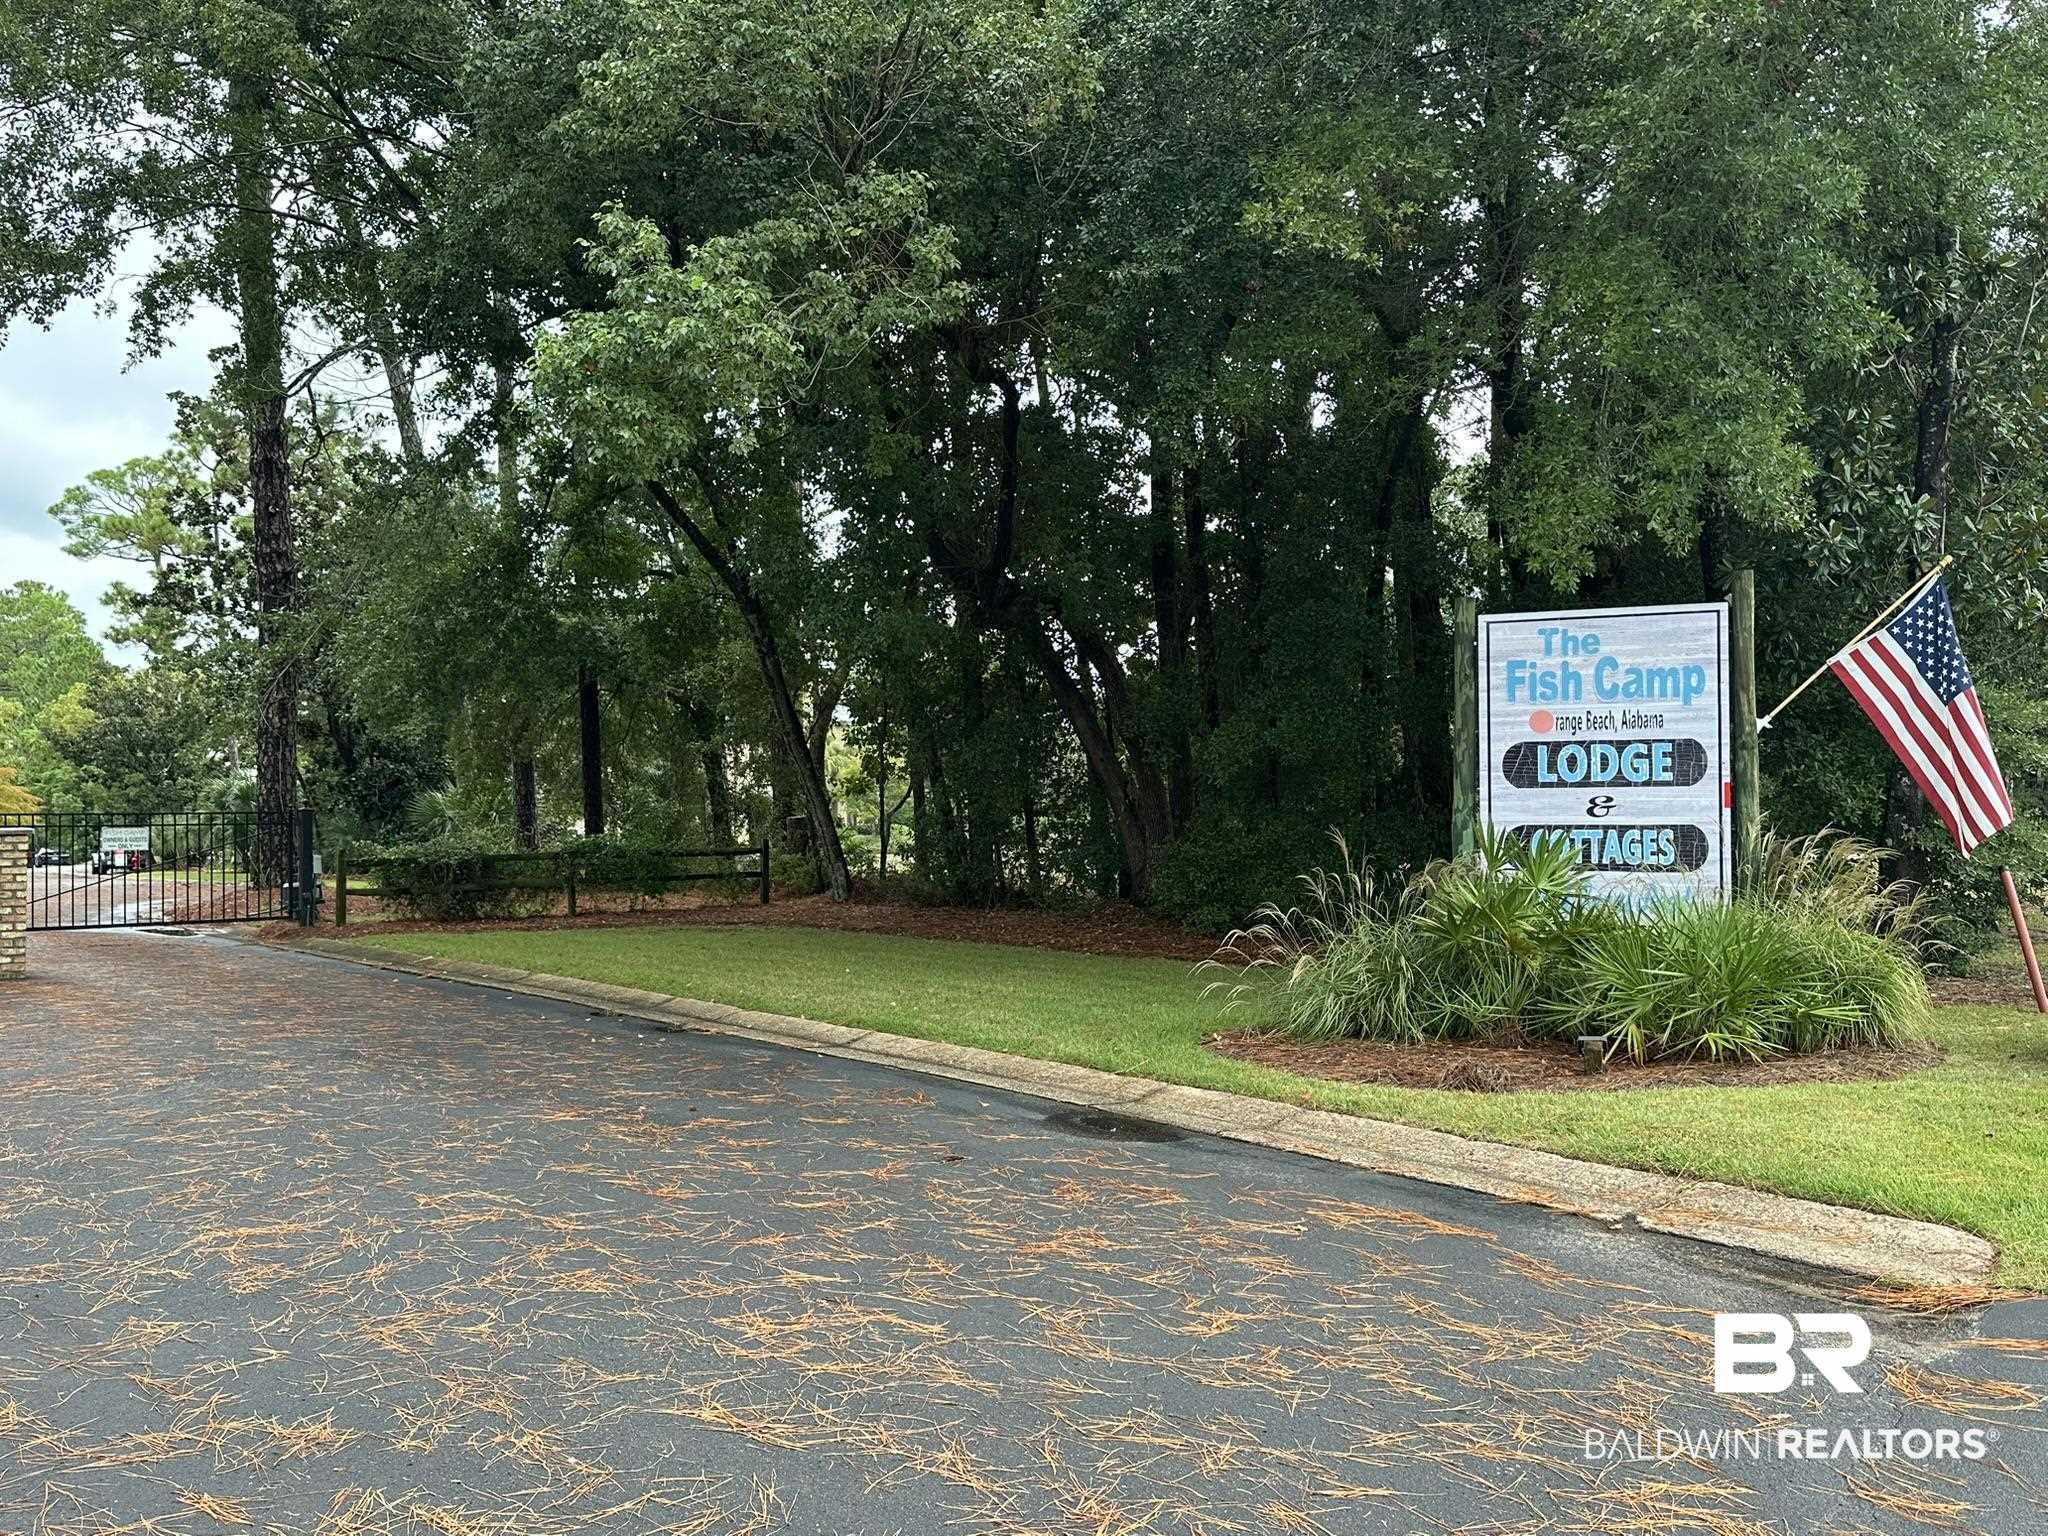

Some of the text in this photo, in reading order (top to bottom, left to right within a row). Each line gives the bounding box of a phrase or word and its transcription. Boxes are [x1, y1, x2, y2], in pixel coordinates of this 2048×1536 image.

[1538, 628, 1600, 656] The
[1506, 656, 1706, 704] Fish Camp
[1586, 710, 1618, 733] Beach,
[1621, 709, 1664, 730] Alabama
[1537, 743, 1674, 783] LODGE
[1586, 795, 1617, 818] &
